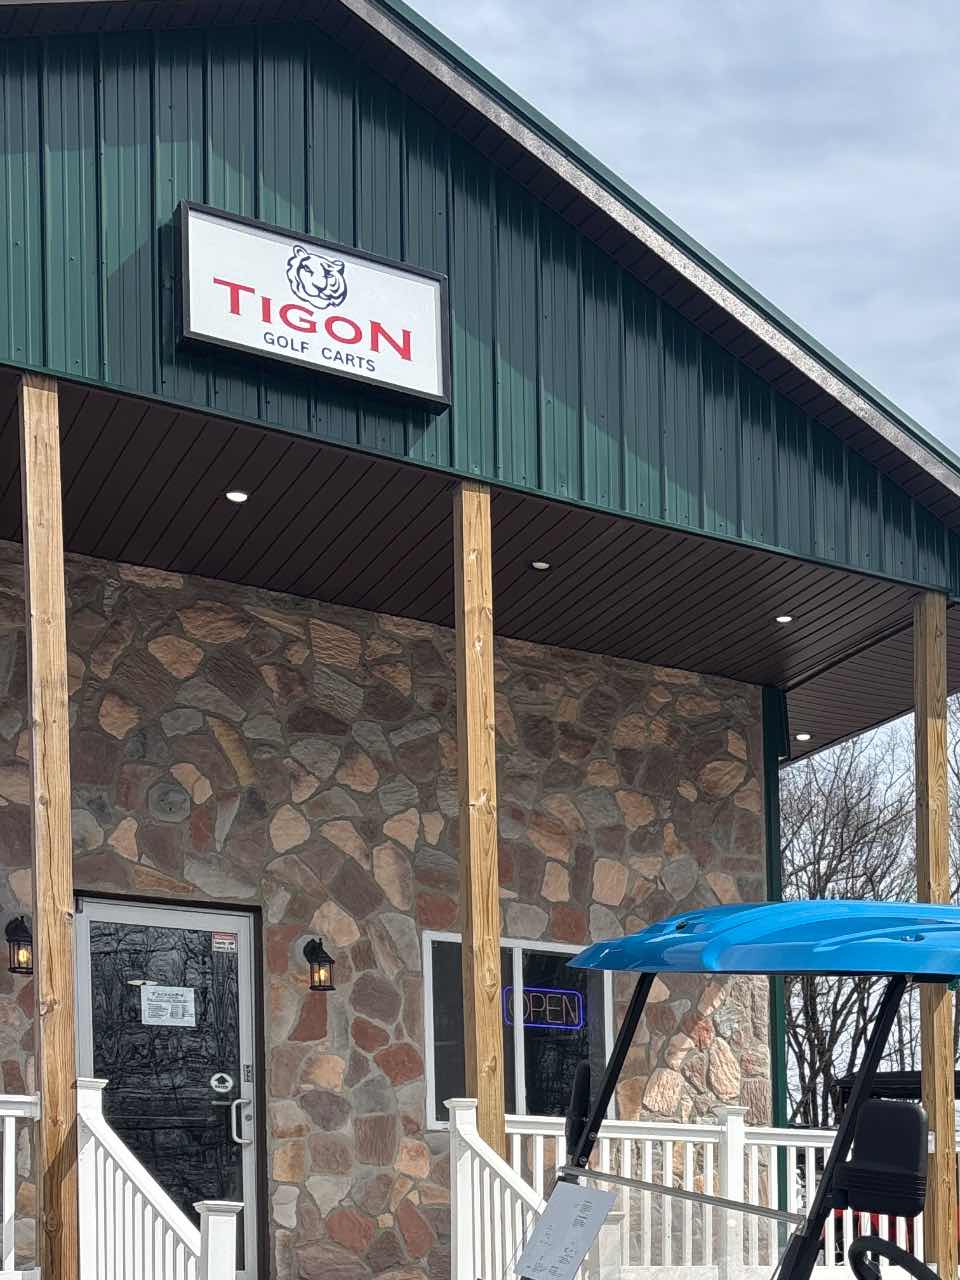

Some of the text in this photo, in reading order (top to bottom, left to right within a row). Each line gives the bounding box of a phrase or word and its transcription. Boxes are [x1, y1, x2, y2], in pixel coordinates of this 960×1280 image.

[213, 278, 413, 361] TIGON
[263, 331, 376, 372] GOLF CARTS
[508, 993, 578, 1024] OPEN
